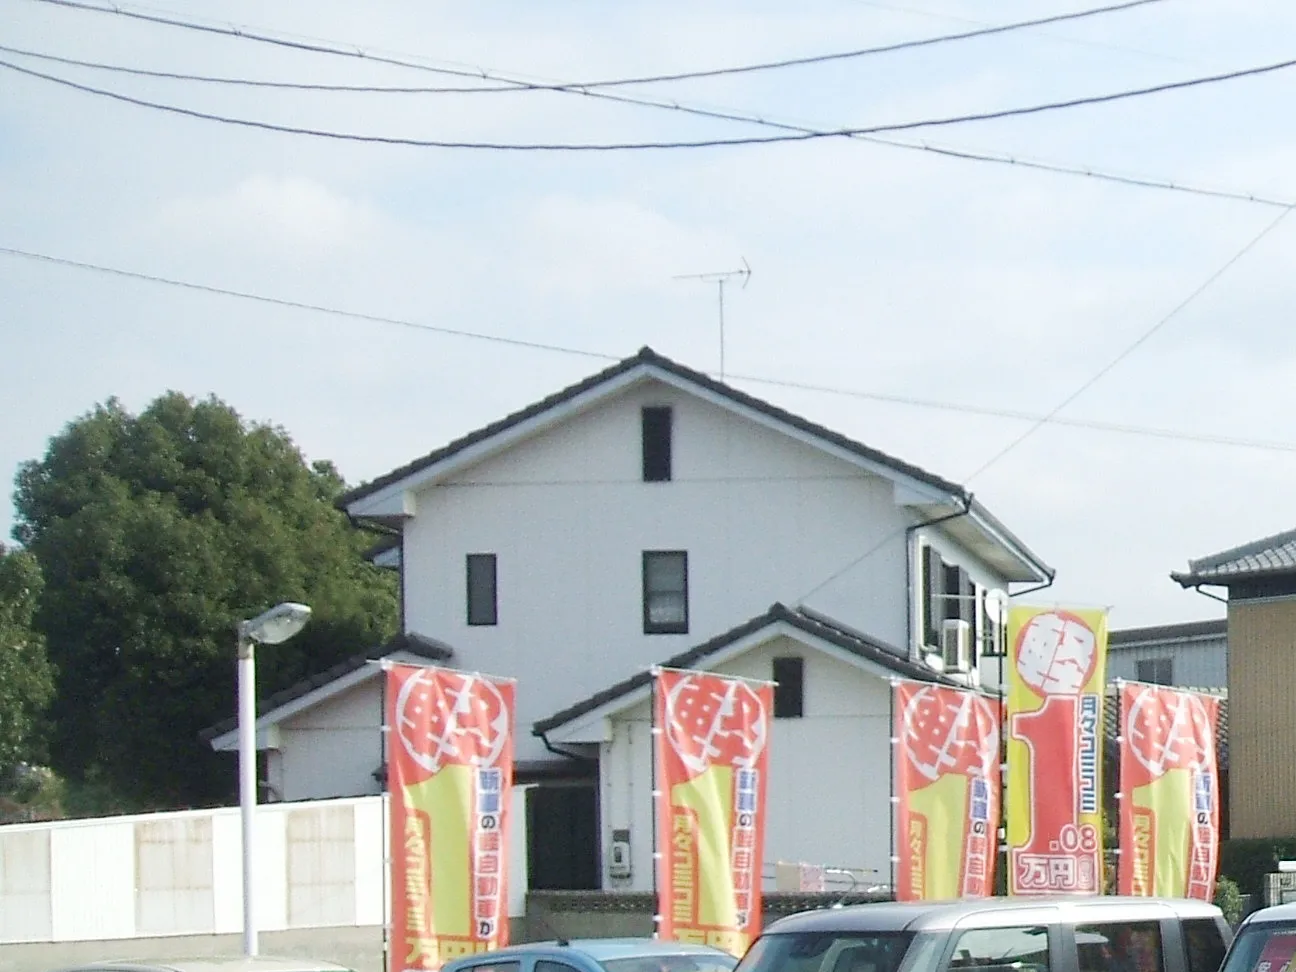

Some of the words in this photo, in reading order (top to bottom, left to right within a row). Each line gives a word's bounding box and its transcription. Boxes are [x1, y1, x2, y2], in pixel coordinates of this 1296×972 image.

[1080, 695, 1097, 812] 月々コミコミ
[1019, 855, 1076, 888] 万円
